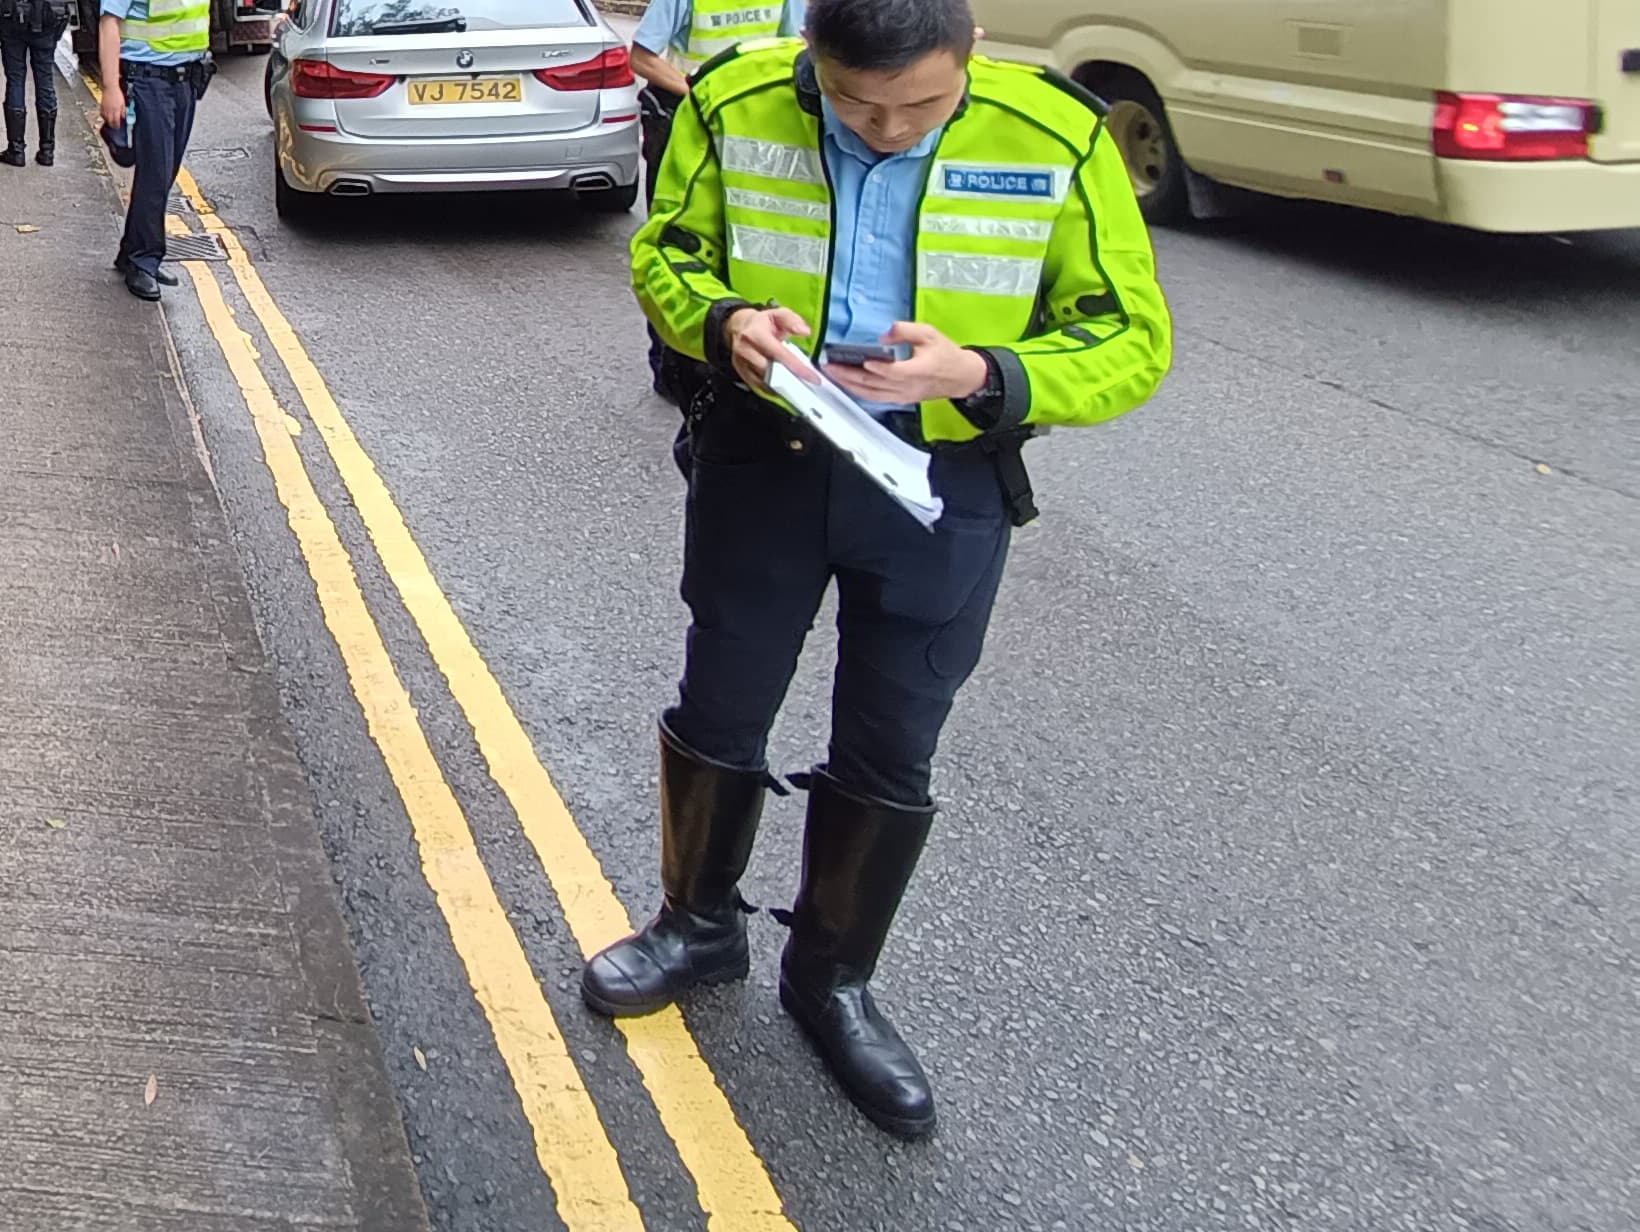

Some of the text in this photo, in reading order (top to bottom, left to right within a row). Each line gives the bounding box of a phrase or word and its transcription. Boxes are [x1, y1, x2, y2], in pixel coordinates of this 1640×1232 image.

[726, 9, 761, 25] POLICE
[413, 81, 517, 102] VJ 7542
[967, 173, 1028, 191] POLICE
